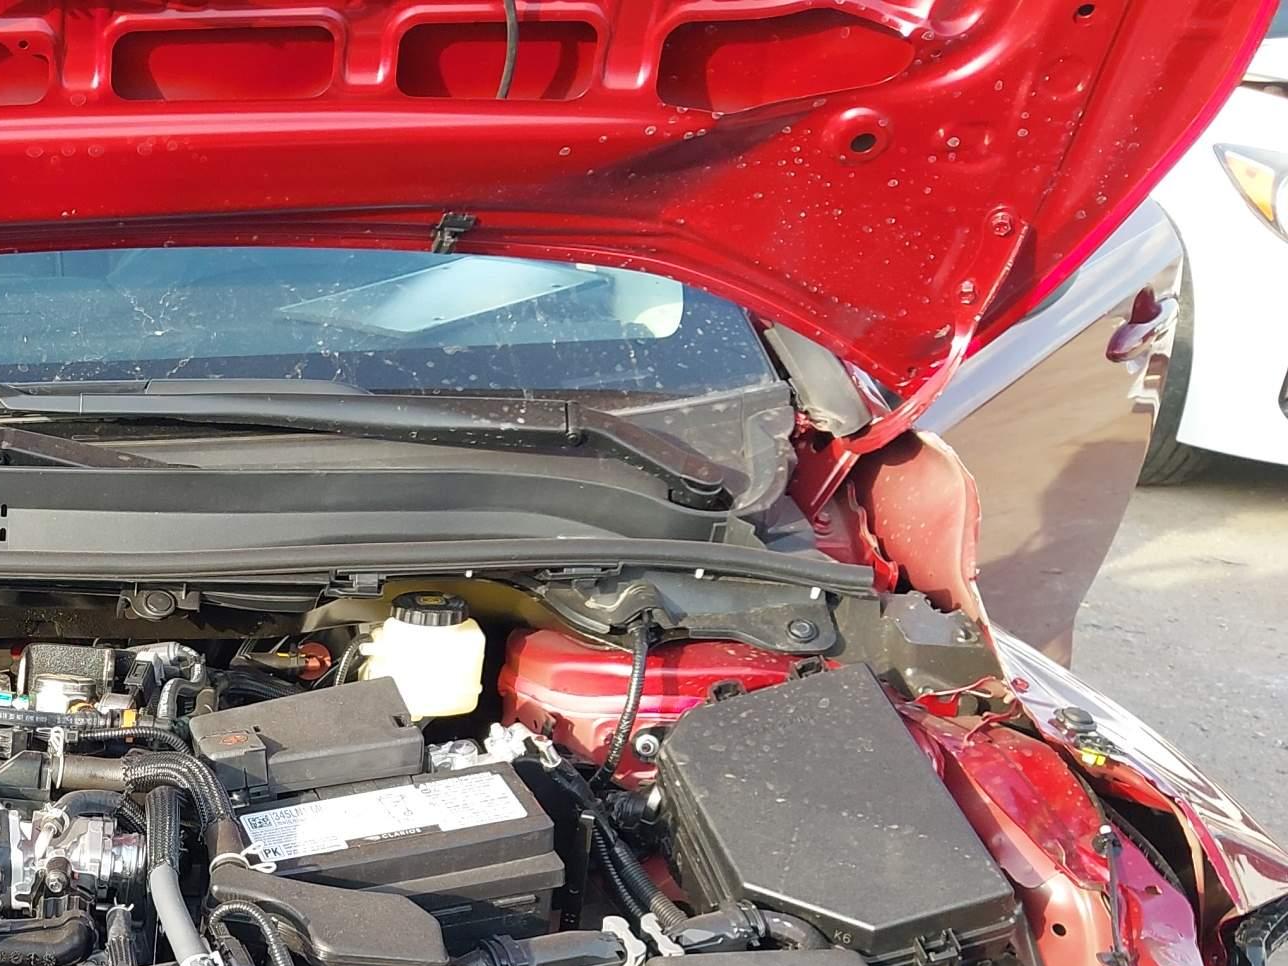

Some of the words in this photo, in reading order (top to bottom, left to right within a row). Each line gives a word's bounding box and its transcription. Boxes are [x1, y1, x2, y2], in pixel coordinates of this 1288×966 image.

[381, 827, 423, 840] CLARIOS
[262, 847, 282, 859] PK
[833, 929, 852, 944] K6
